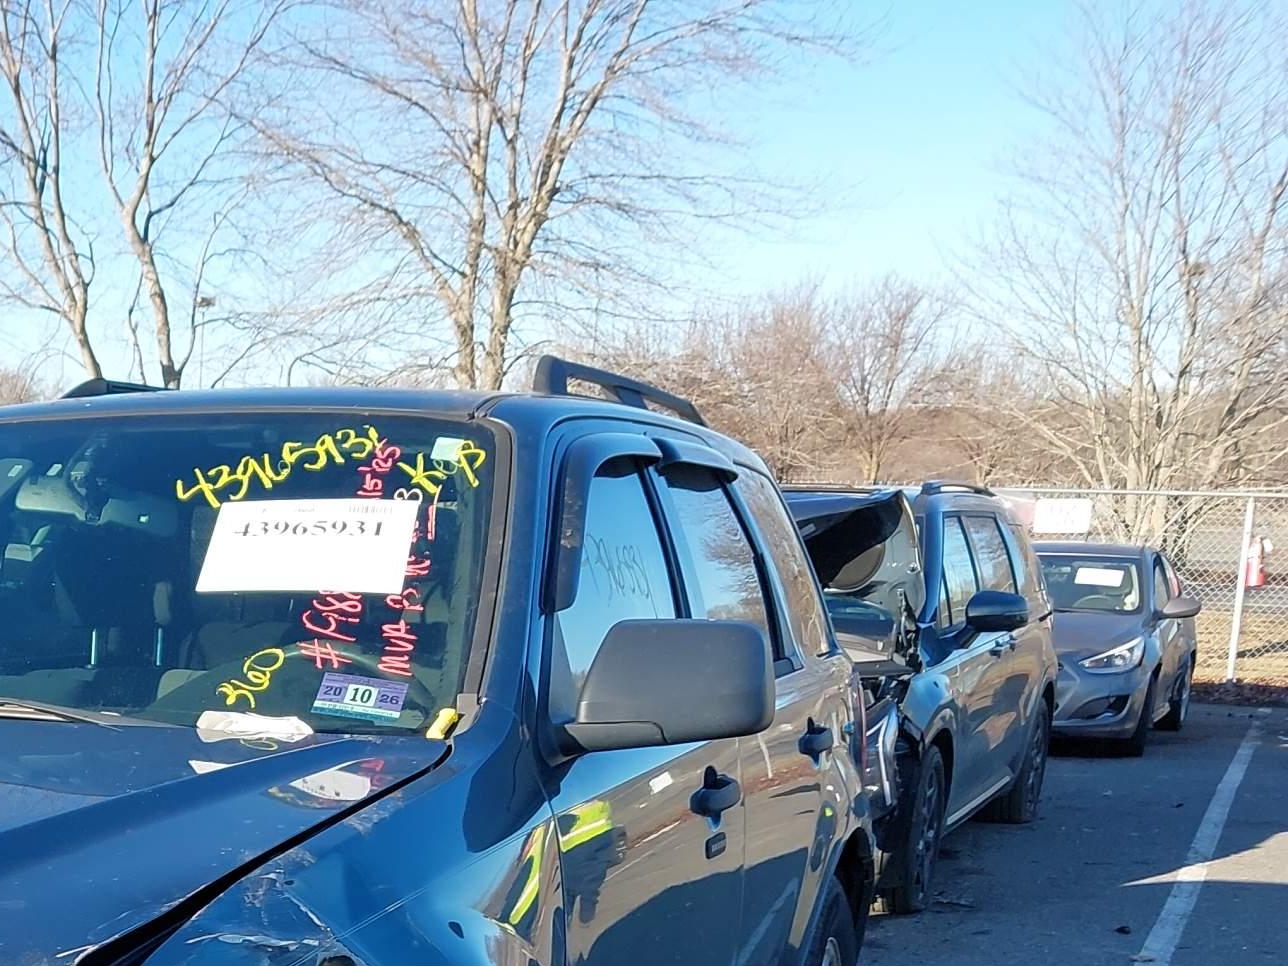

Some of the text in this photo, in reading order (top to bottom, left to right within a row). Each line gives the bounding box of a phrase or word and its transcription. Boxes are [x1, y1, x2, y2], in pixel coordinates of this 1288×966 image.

[233, 519, 383, 537] 43965931
[323, 684, 401, 706] 20 10 26
